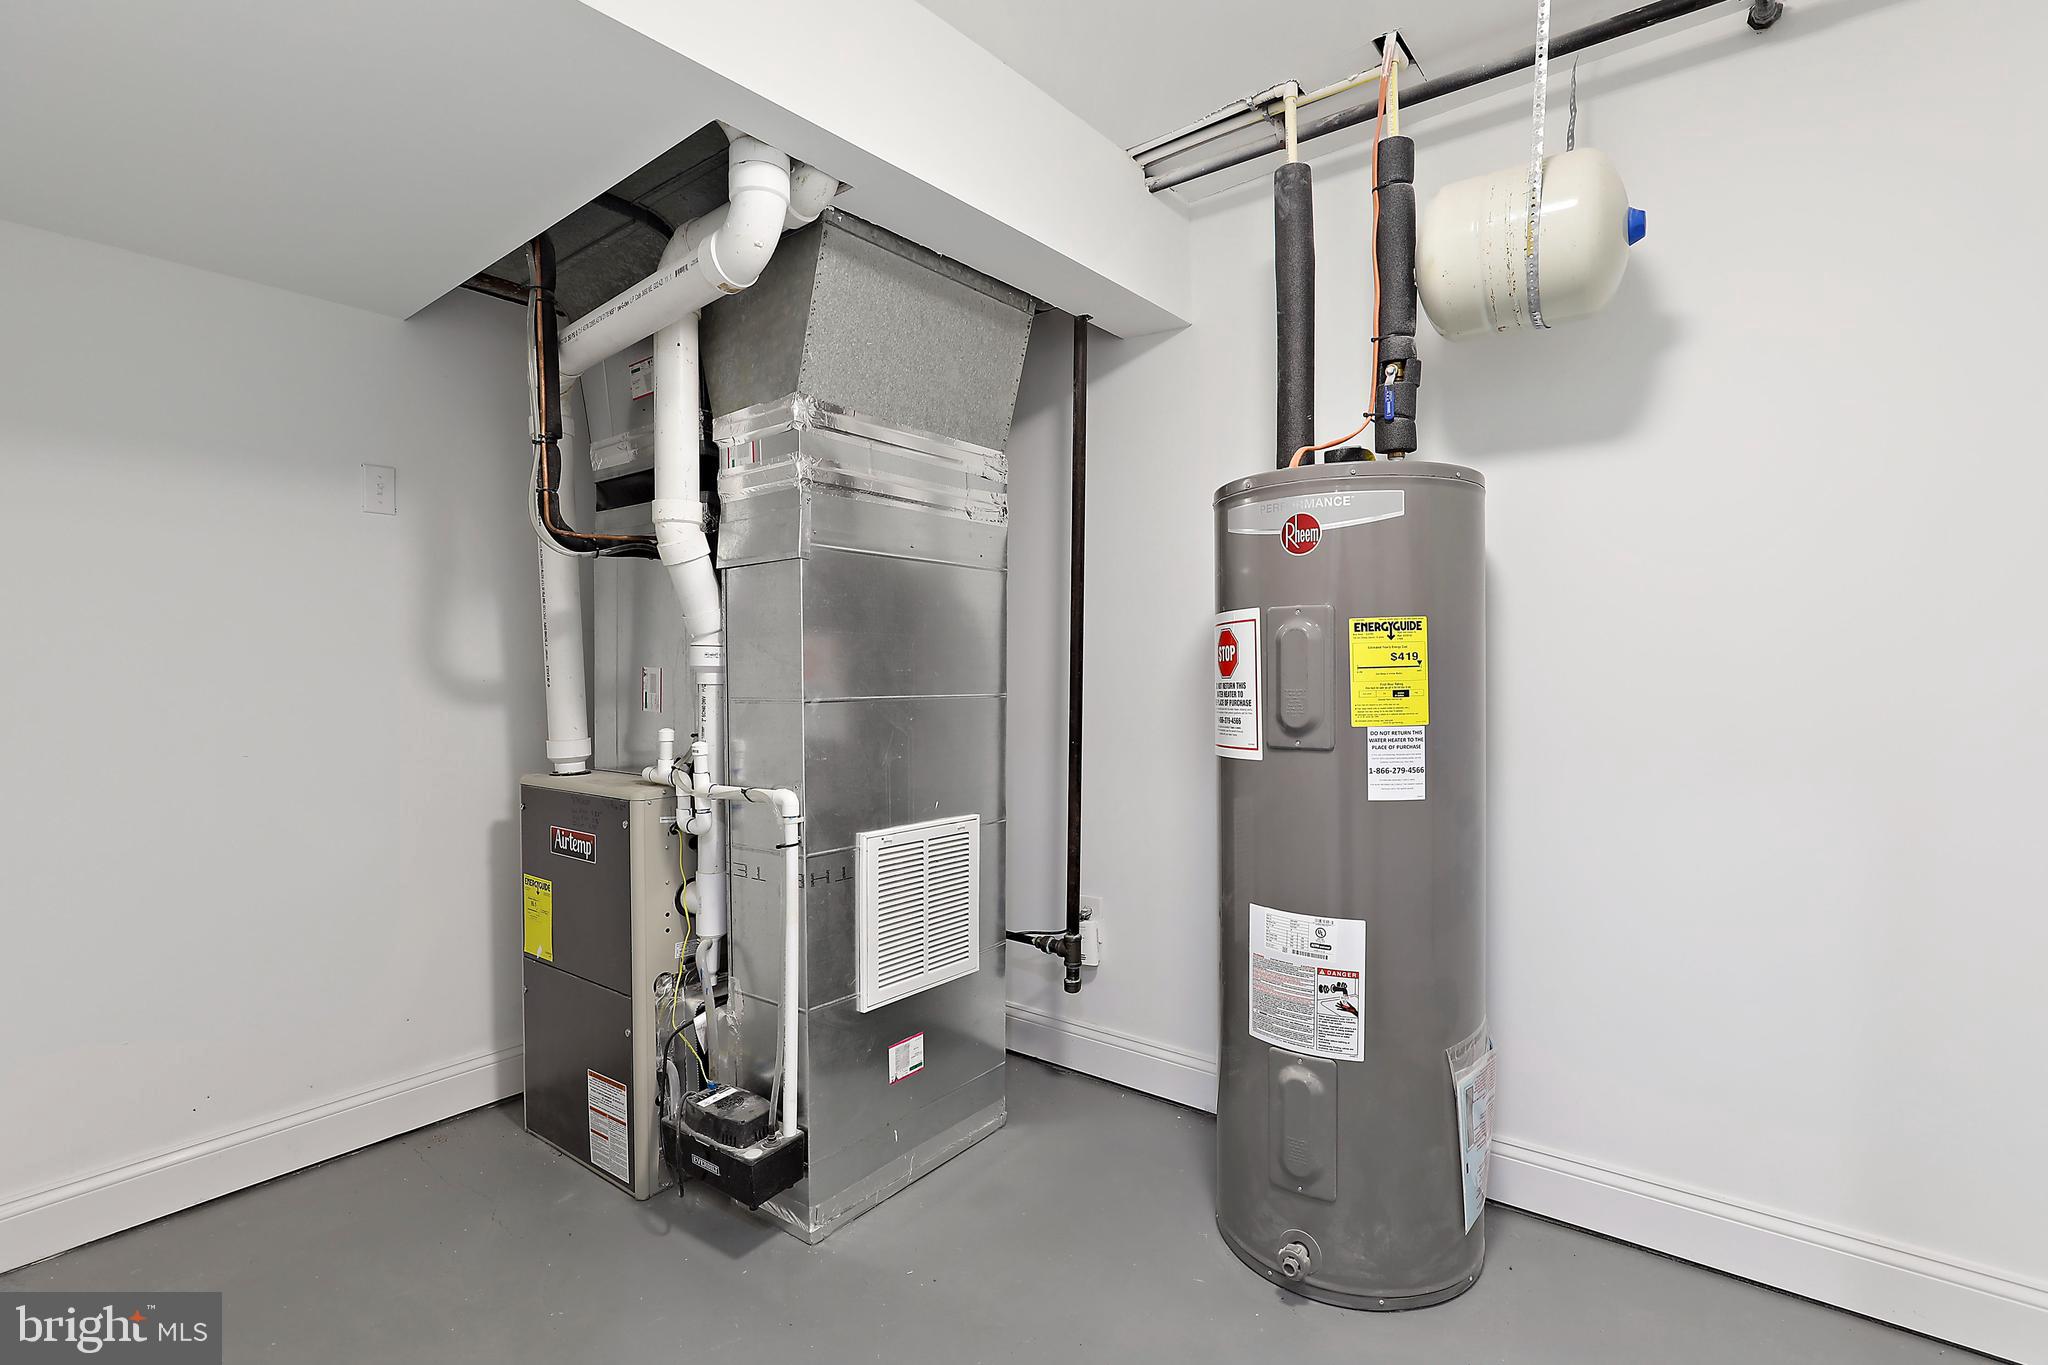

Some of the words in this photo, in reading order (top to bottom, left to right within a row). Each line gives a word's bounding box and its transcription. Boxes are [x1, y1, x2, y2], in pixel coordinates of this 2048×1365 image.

[1260, 495, 1352, 514] PERFRMANCE
[1285, 514, 1319, 549] Rheem
[1354, 621, 1422, 633] ENERGYGUIDE
[1219, 645, 1236, 662] STOP
[1390, 652, 1418, 661] $419
[1369, 766, 1425, 774] 1-866-279-4566
[554, 829, 592, 859] Airtemp
[524, 877, 551, 893] ENERGYGUIDE
[1327, 970, 1358, 978] DANGER
